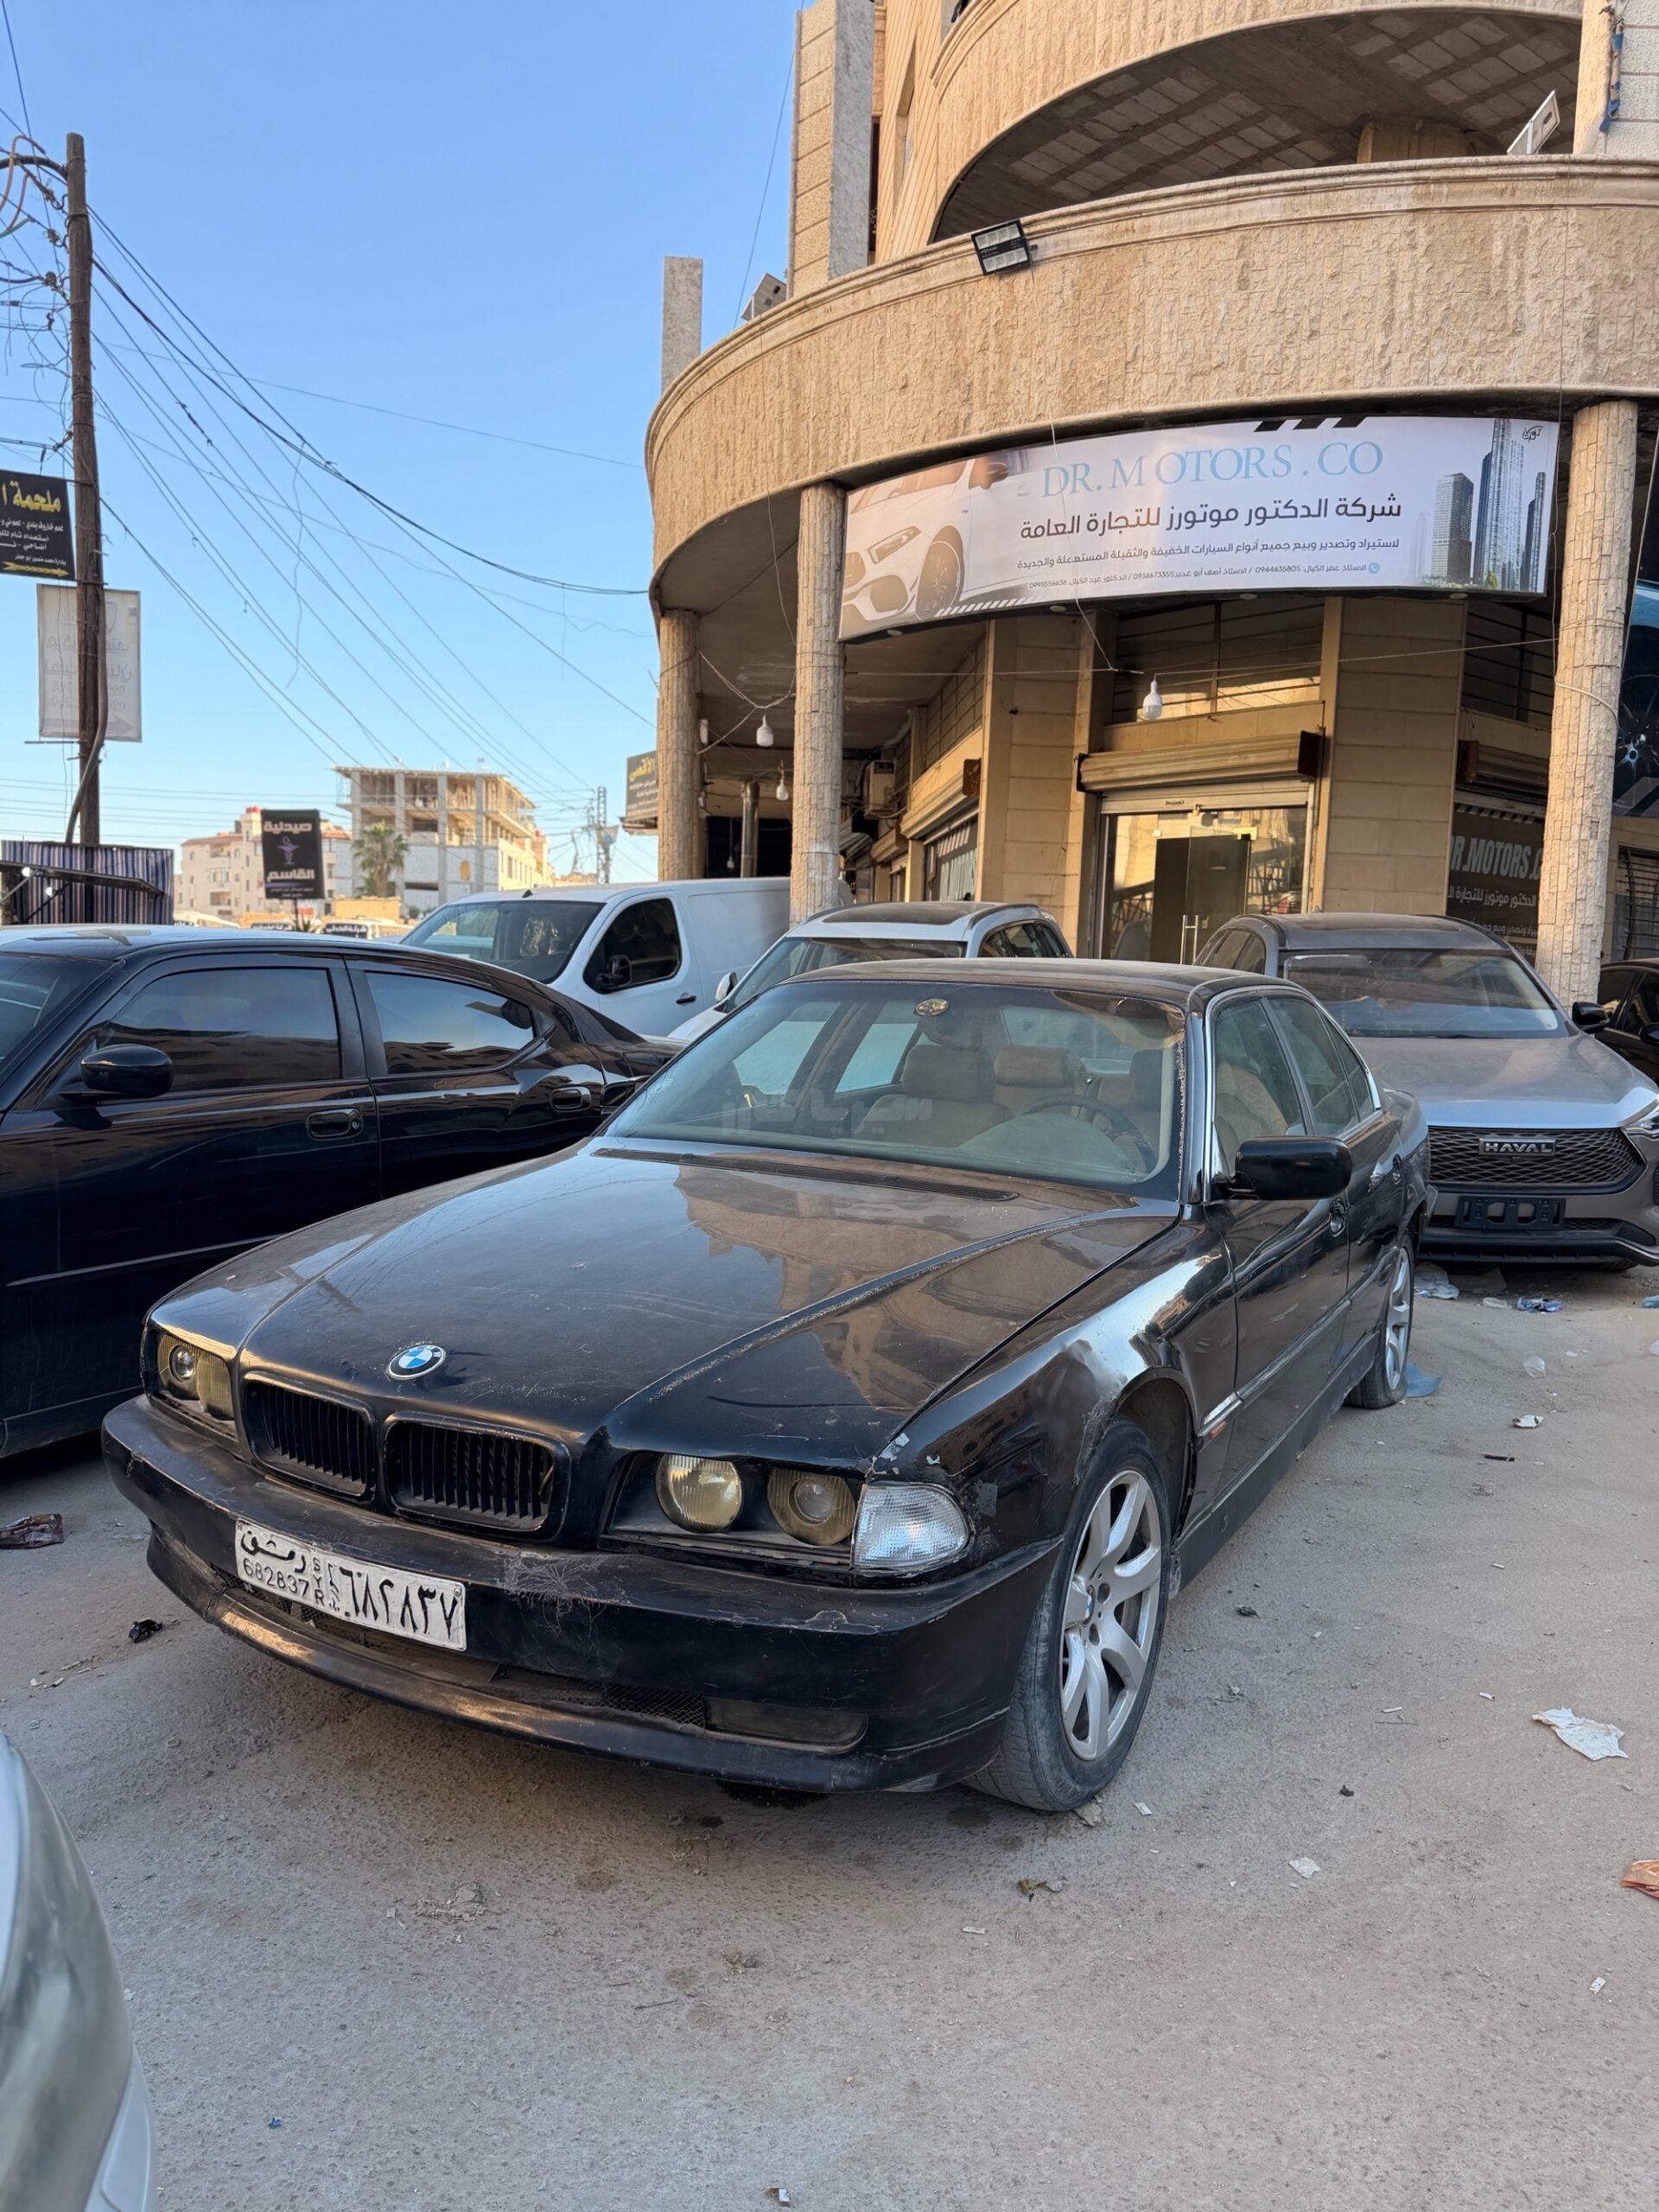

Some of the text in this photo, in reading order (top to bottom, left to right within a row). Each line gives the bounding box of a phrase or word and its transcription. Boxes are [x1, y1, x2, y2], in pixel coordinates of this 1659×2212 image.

[12, 480, 61, 512] ملحمة
[1020, 493, 1402, 539] شركة الدكتور موتورز للتجارة العامة
[1151, 545, 1190, 557] الخفيفة
[1192, 543, 1234, 556] السيارات
[1234, 539, 1259, 554] أنواع
[1260, 542, 1291, 552] جميع
[1294, 542, 1316, 551] وبيع
[1319, 540, 1357, 551] وتصدير
[1111, 547, 1149, 560] والثقيلة
[1017, 558, 1055, 569] والجديدة
[264, 821, 312, 835] صيدلية
[267, 868, 315, 882] القاسم
[1455, 886, 1484, 904] للتجارة
[1484, 889, 1509, 906] موتورز
[1510, 893, 1537, 908] الدكتور
[1484, 1142, 1554, 1153] HAVAL
[243, 1557, 309, 1597] 682837
[339, 1566, 458, 1639] ٦٨٢٨٣٧
